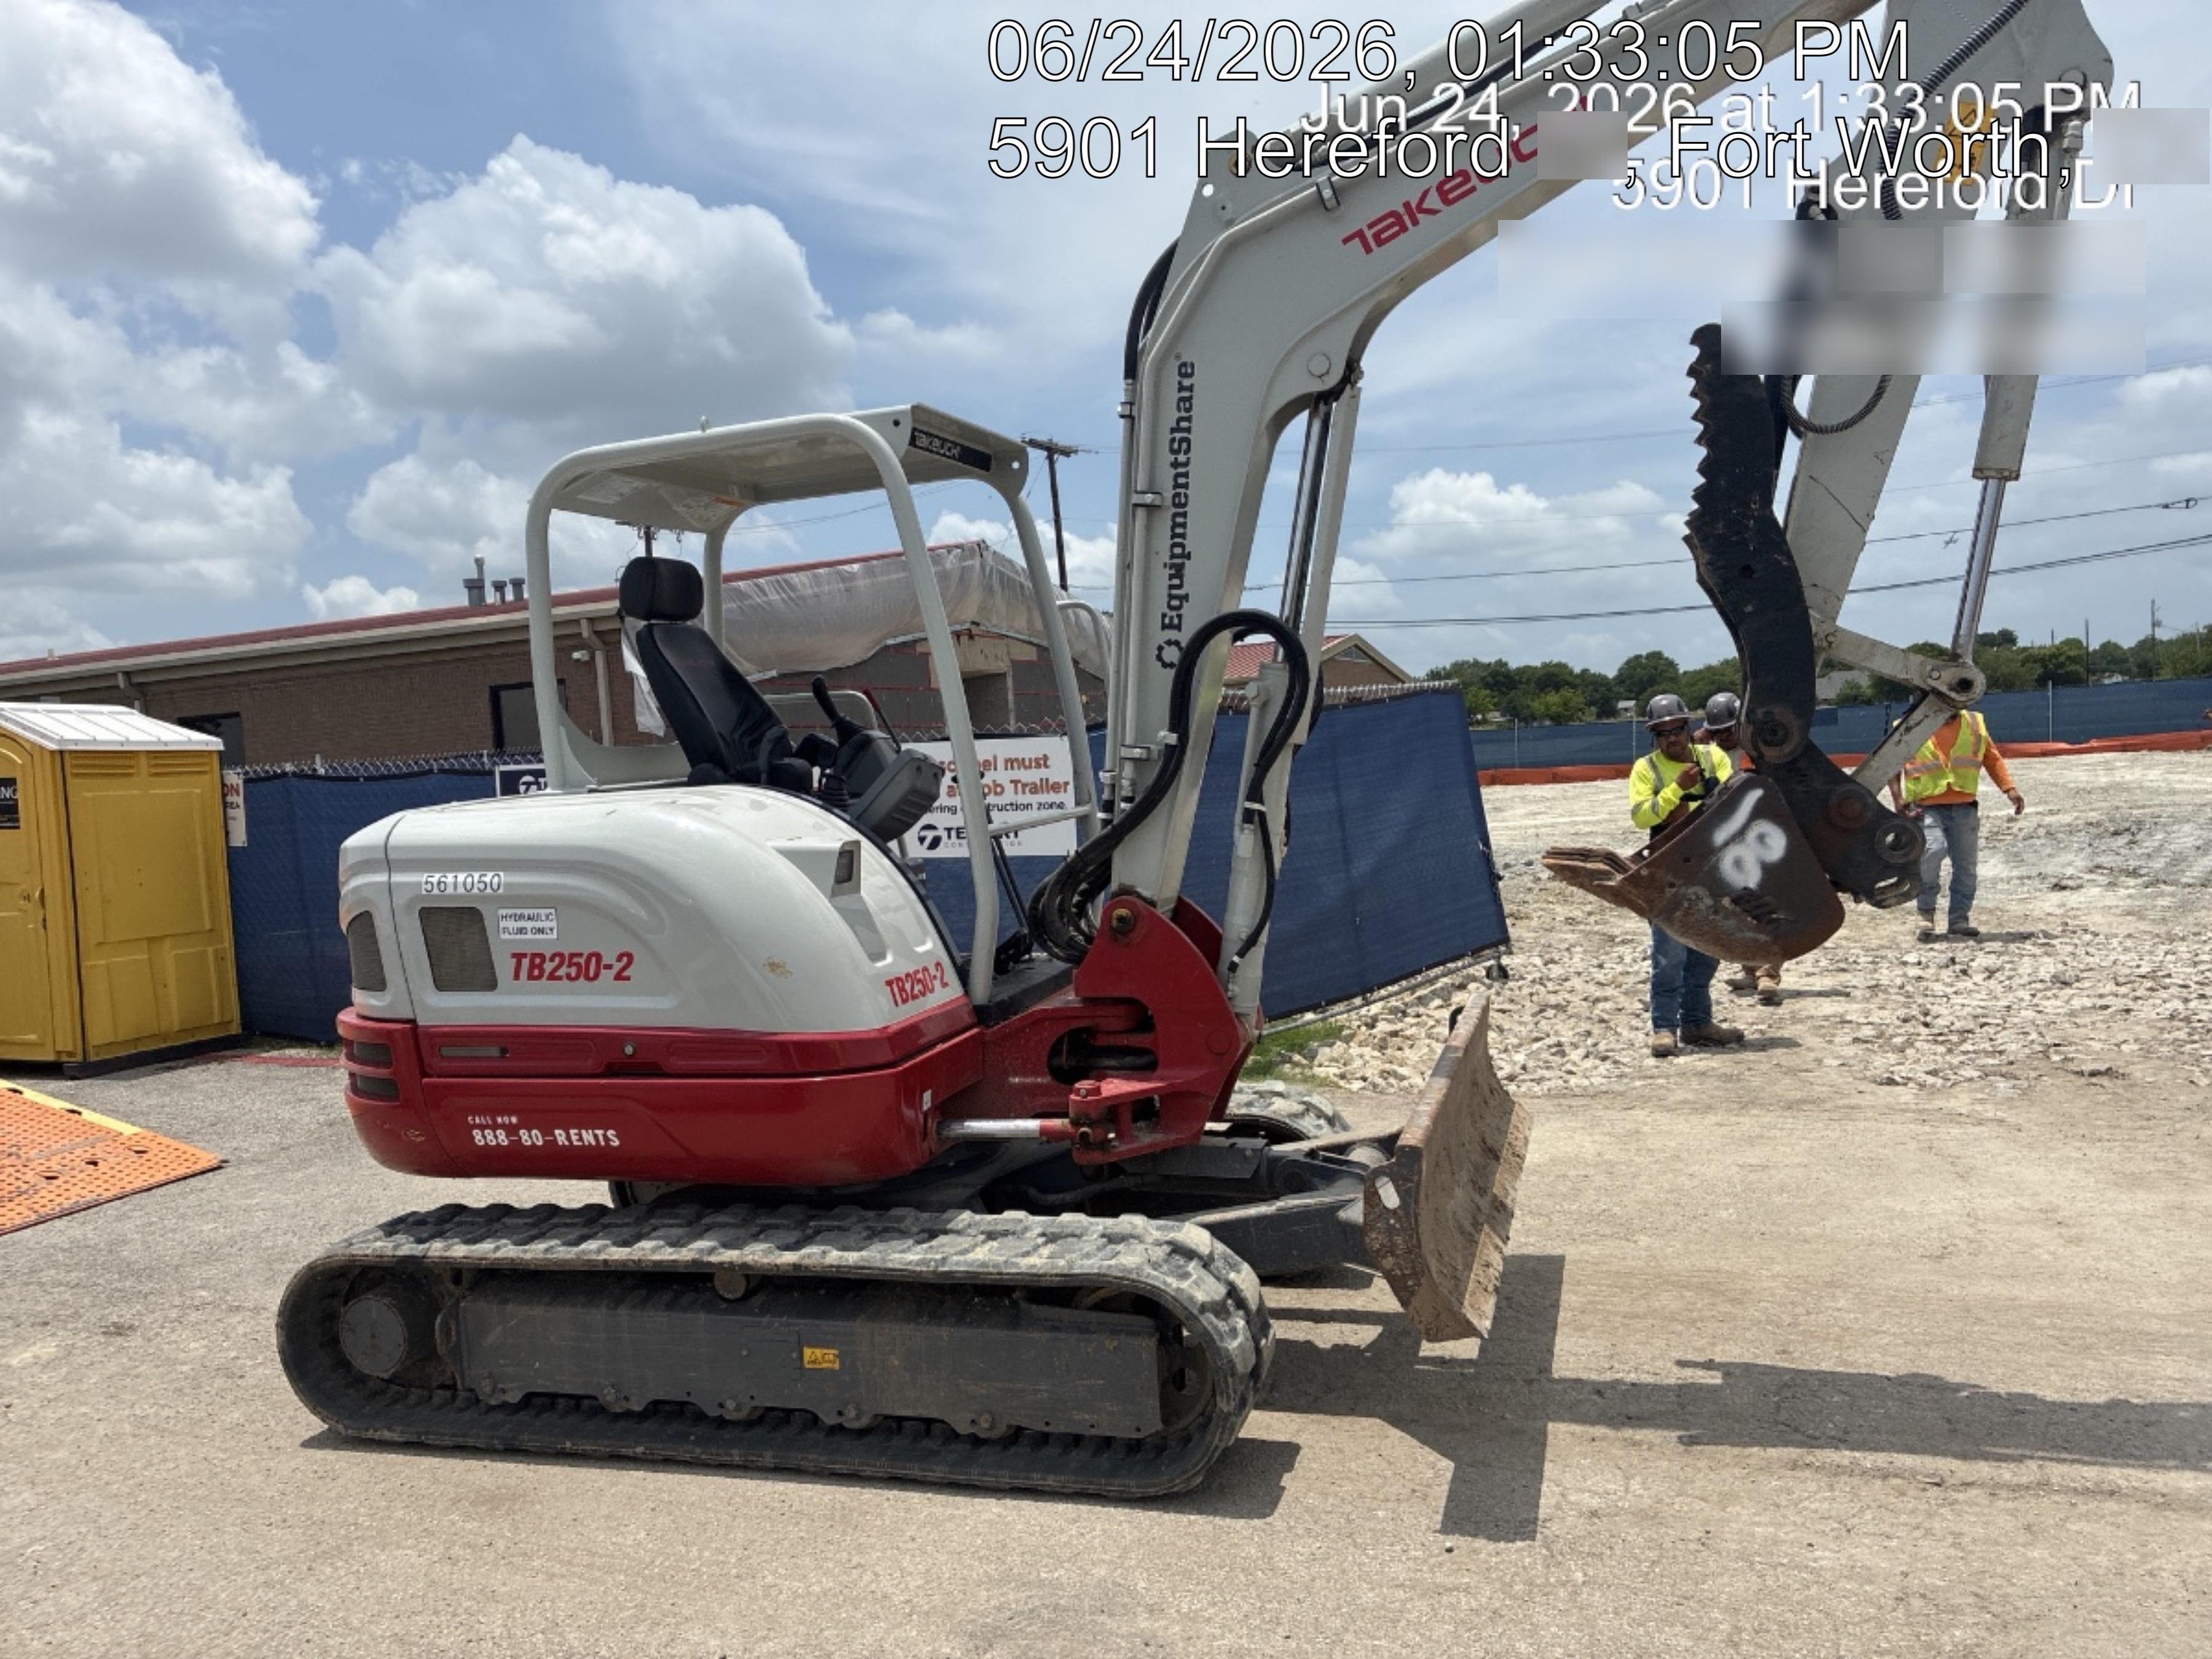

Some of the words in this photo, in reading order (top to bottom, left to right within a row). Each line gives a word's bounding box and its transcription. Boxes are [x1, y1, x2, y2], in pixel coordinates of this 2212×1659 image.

[1161, 360, 1196, 633] EquipmentShare
[1003, 753, 1050, 771] must
[982, 780, 1005, 797] ob
[1010, 778, 1070, 794] Trailer
[423, 873, 502, 893] 561050
[501, 912, 554, 922] HYDRAULIC
[501, 926, 528, 935] FLUID
[530, 926, 555, 935] ONLY
[510, 951, 635, 982] TB250-2
[885, 961, 950, 1008] TB250-2
[468, 1115, 492, 1125] CALL
[496, 1115, 519, 1124] NOW
[471, 1129, 620, 1147] 888-80-RENTS
